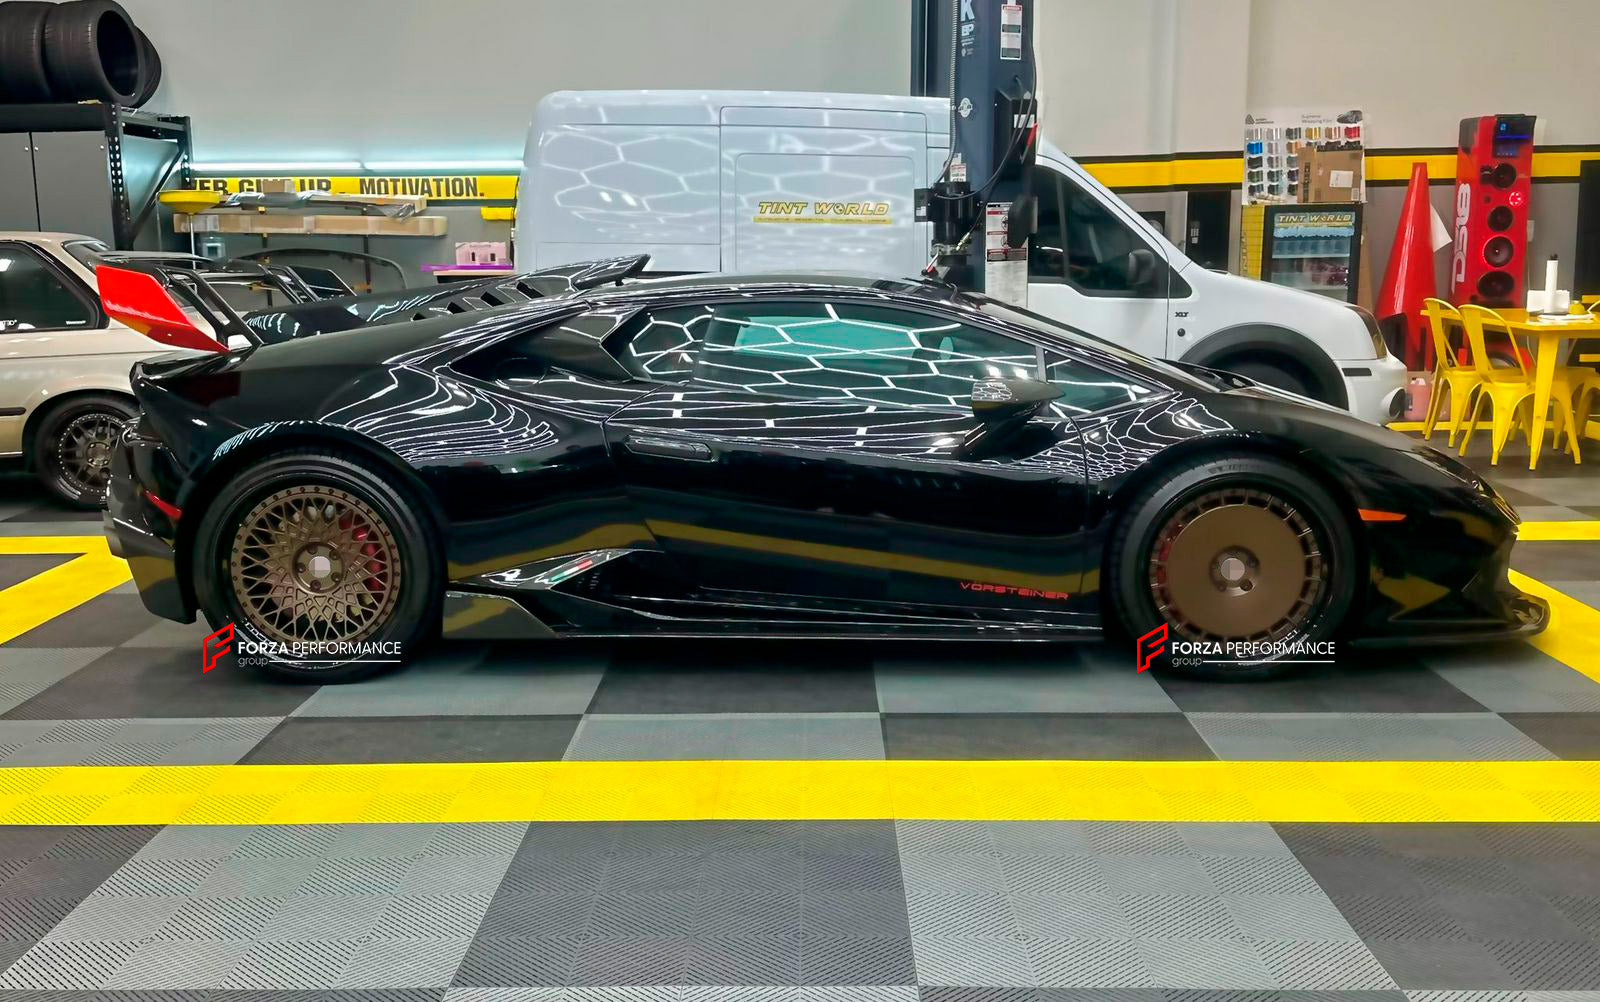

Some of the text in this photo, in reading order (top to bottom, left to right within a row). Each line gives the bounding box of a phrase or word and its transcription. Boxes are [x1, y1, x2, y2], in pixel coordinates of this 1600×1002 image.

[191, 179, 229, 195] ER
[359, 177, 485, 198] MOTIVATION.
[758, 201, 889, 216] TINT WORLD
[1278, 214, 1352, 223] TINT WORLD
[960, 581, 1069, 600] VORSTEINER
